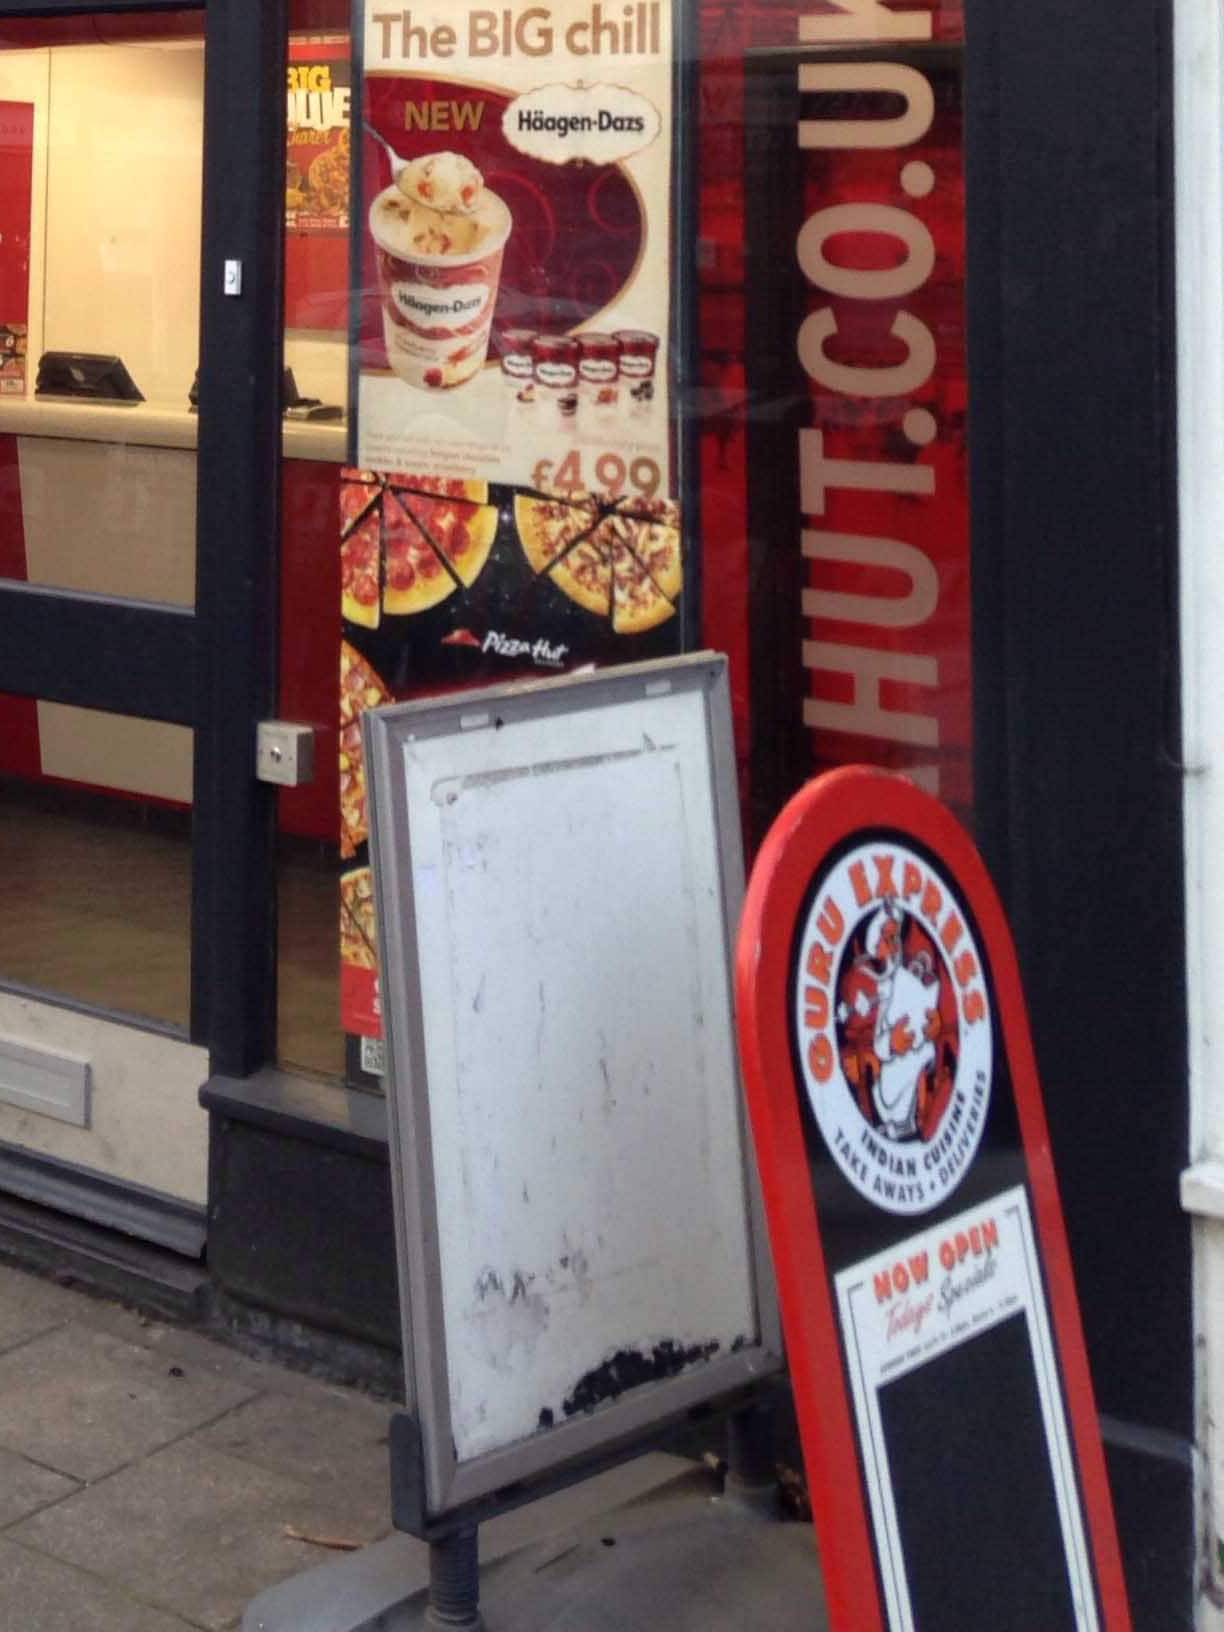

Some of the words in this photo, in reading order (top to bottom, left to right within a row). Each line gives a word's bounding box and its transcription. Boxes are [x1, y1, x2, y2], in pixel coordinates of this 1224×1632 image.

[372, 10, 457, 59] The
[469, 7, 554, 57] BIG
[565, 2, 660, 55] chill
[404, 100, 485, 132] NEW
[518, 110, 644, 138] Häagen-Dazs
[482, 629, 531, 657] Pizza
[532, 637, 570, 661] Hut
[848, 854, 987, 1026] EXPRESS
[835, 1126, 868, 1184] TAKE
[872, 1173, 926, 1203] AWAYS
[938, 1069, 987, 1186] DELIVERIES
[861, 1127, 917, 1176] INDIAN
[923, 1088, 966, 1171] CUISINE
[872, 1247, 930, 1305] NOW
[938, 1216, 1000, 1272] OPEN
